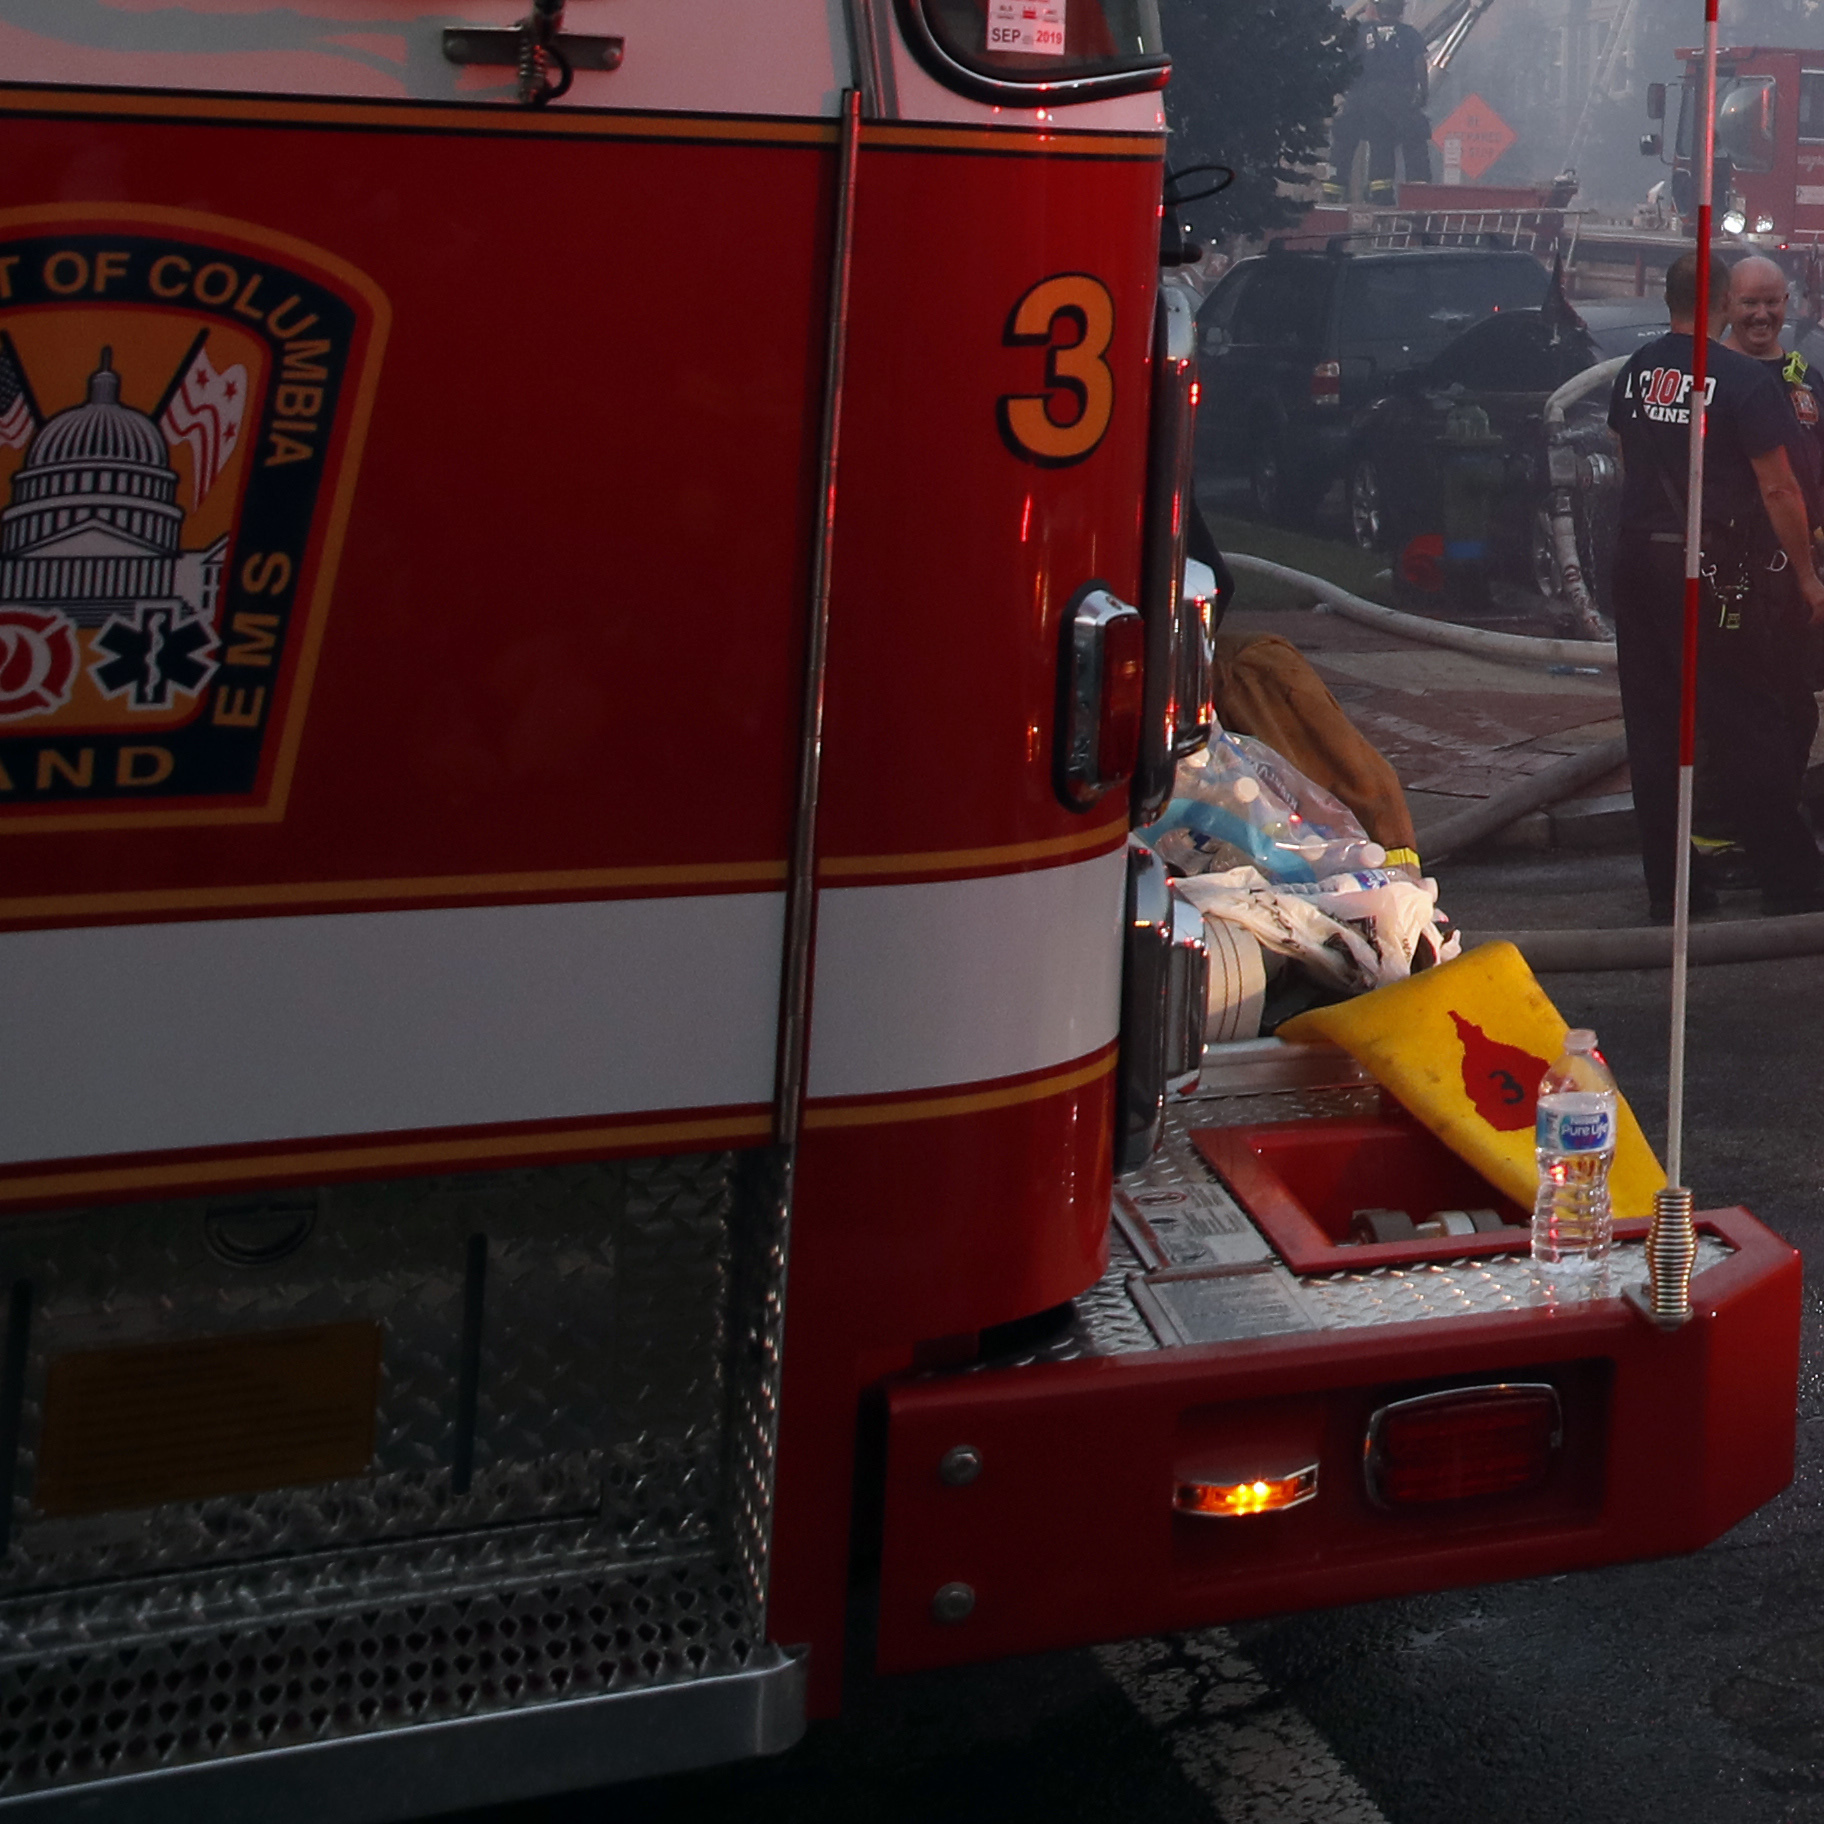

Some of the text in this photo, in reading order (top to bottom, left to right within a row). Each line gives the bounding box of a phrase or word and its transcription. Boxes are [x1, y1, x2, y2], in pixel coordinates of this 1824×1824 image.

[991, 27, 1063, 45] SEP 2019
[43, 250, 131, 295] OF
[147, 254, 332, 468] COLUMBIA
[998, 272, 1116, 468] 3
[211, 550, 293, 729] EMS
[1488, 1069, 1525, 1106] 3
[1561, 1123, 1610, 1140] Pure Life
